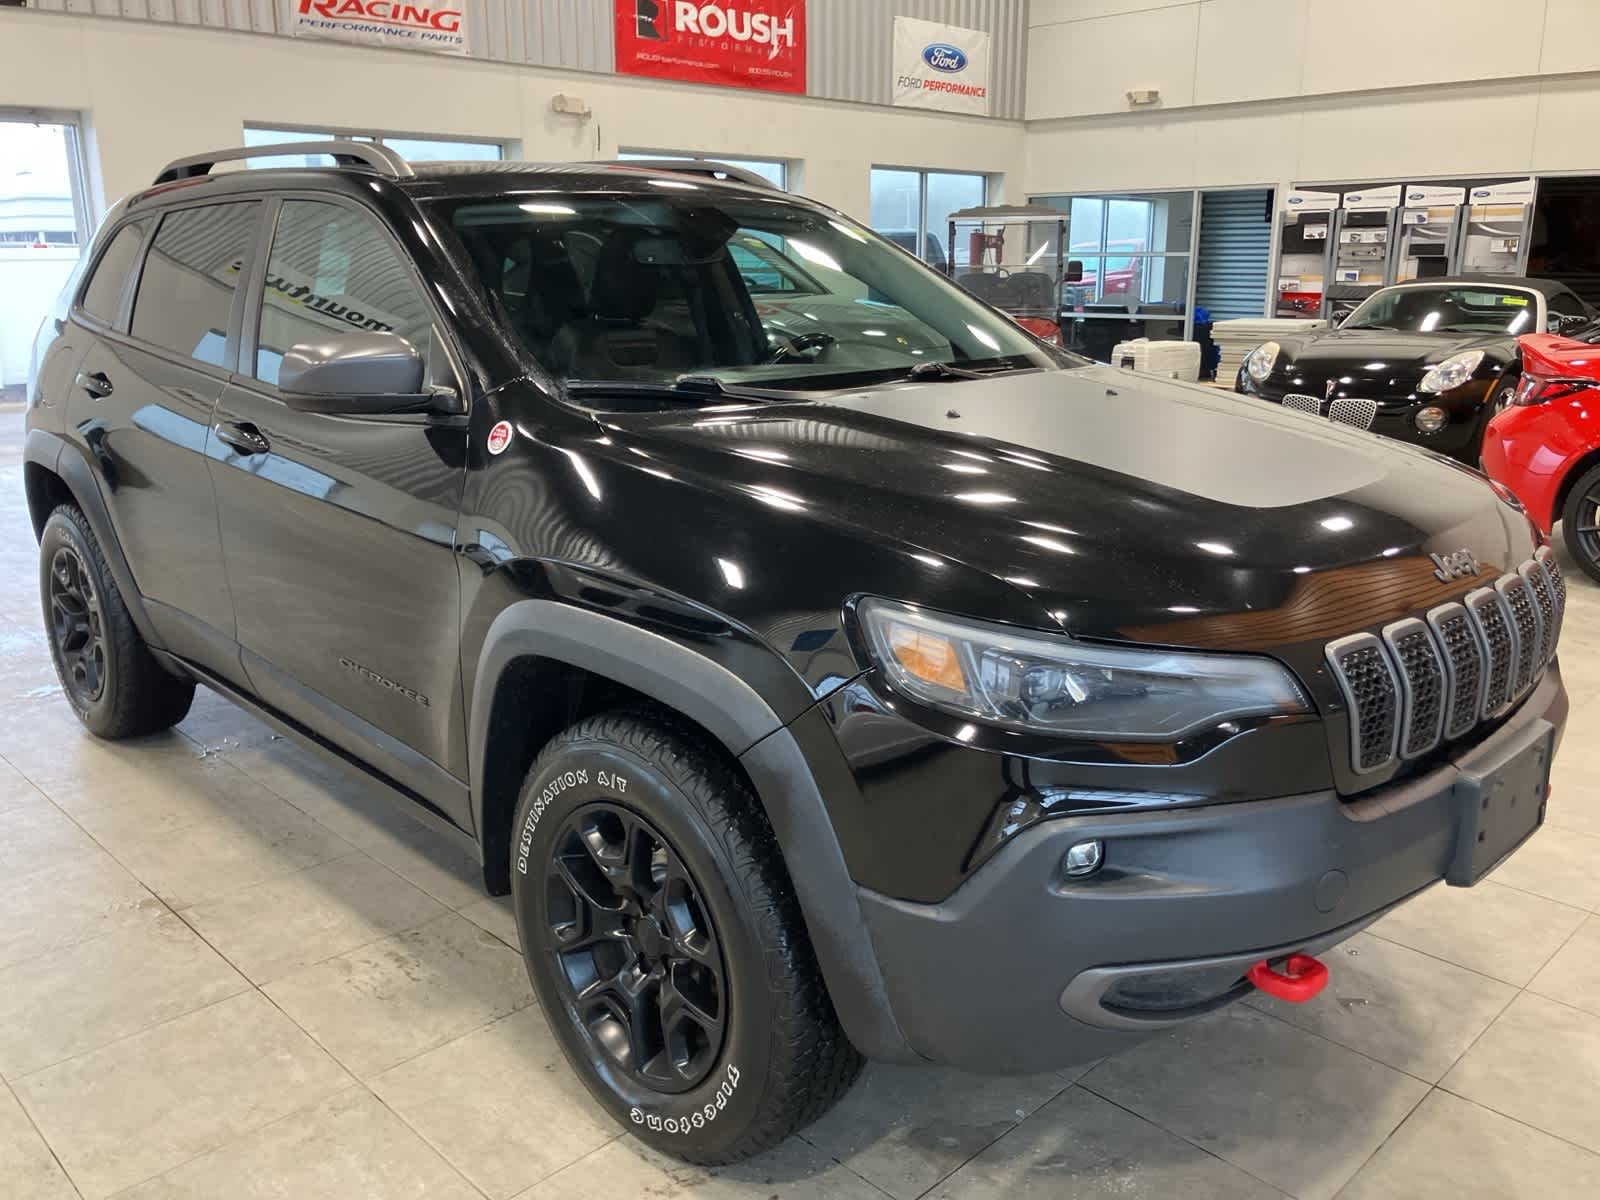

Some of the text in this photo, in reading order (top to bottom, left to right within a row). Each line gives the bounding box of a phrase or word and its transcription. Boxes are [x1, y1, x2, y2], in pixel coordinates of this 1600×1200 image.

[298, 0, 462, 33] RACING
[298, 17, 463, 45] PERFORMANCE PARTS
[675, 1, 793, 57] ROUSH
[930, 47, 960, 69] Ford
[896, 76, 986, 98] FORD PERFORMANCE
[1429, 549, 1480, 585] Jeep
[517, 768, 628, 875] DESTINATION A/T
[629, 1063, 740, 1135] Firestone
